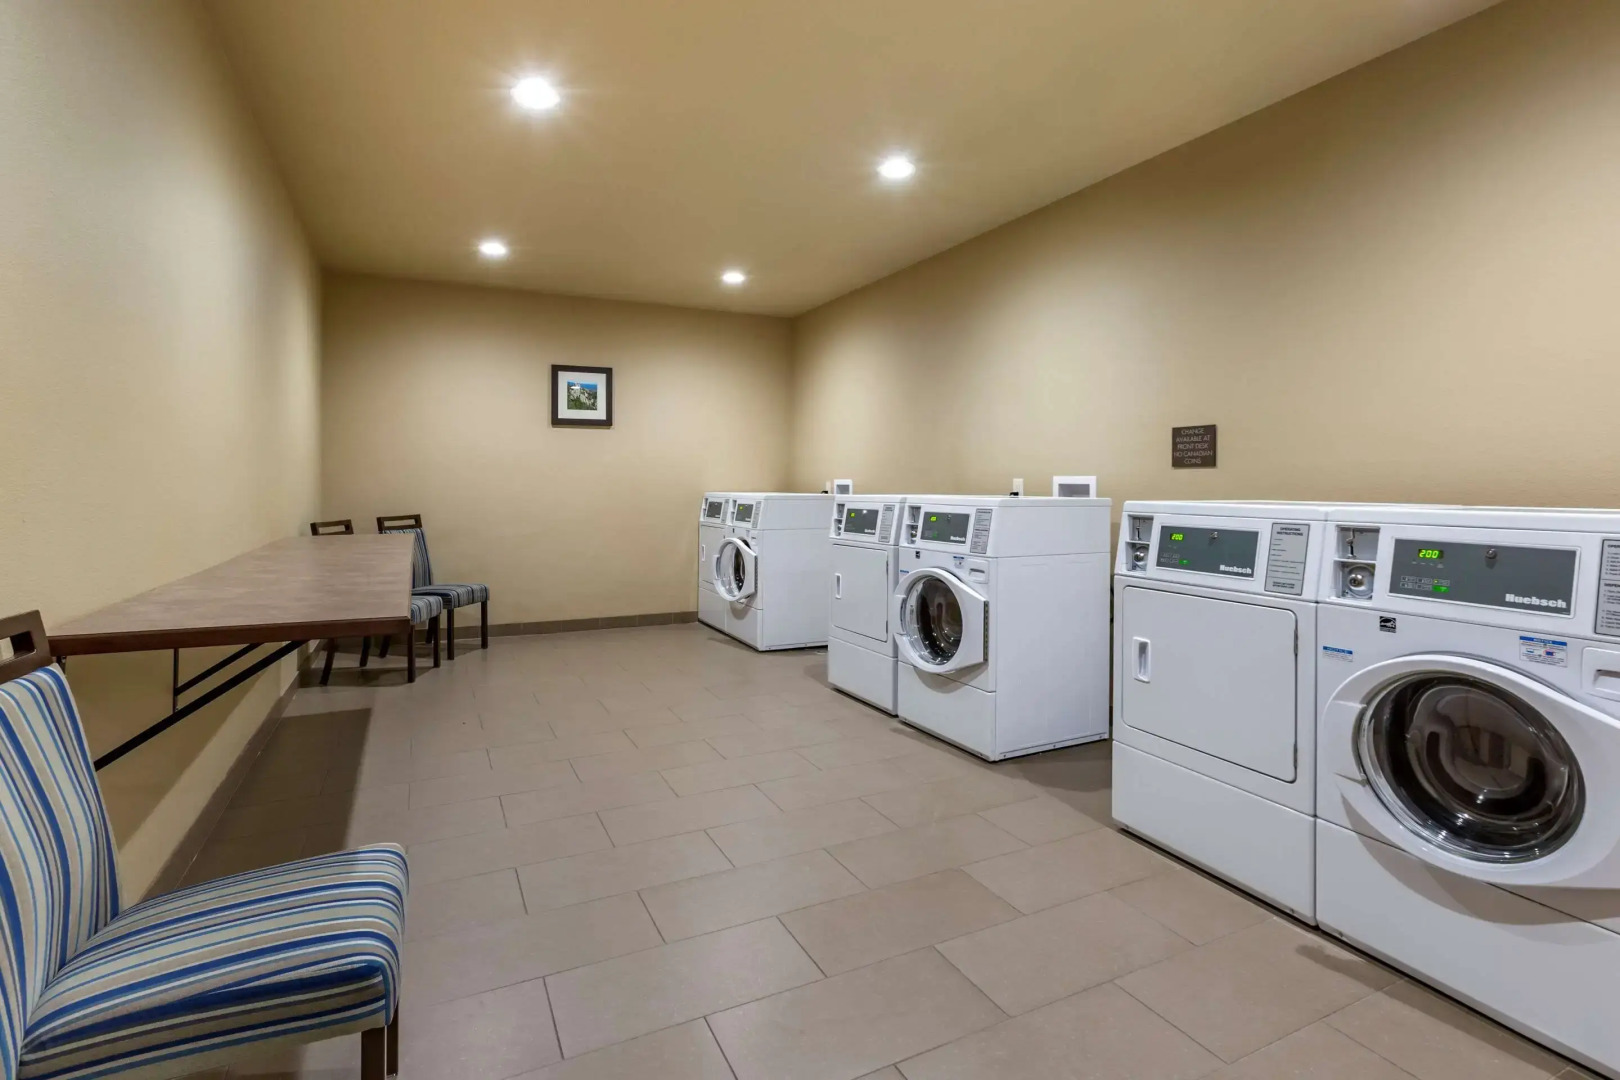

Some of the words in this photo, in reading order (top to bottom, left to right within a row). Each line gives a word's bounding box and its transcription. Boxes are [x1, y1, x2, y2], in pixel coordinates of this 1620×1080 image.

[1419, 549, 1439, 559] 200
[1219, 564, 1252, 574] Huebsch
[1505, 594, 1567, 608] Huebsch
